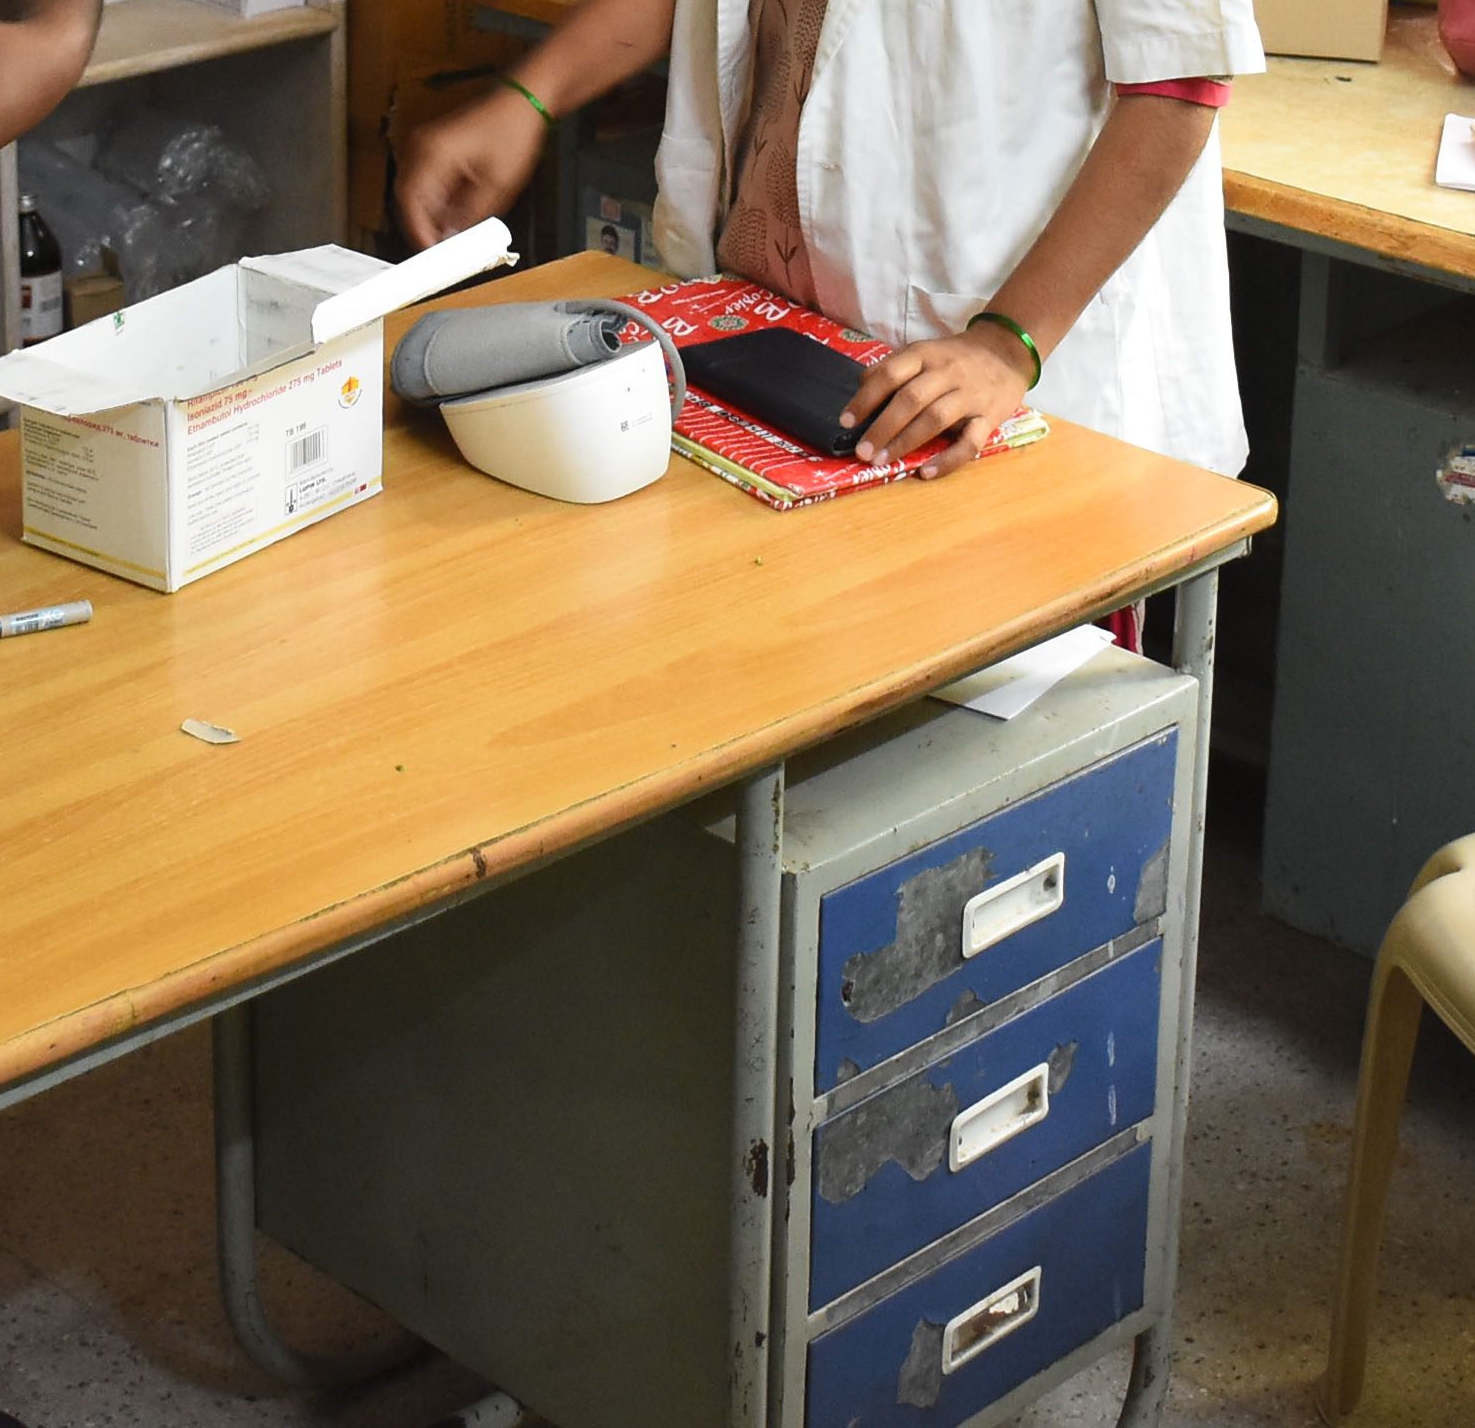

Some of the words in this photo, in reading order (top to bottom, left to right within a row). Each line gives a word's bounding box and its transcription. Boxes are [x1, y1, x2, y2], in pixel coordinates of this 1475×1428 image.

[187, 409, 232, 435] Ethambutol
[233, 385, 287, 415] Hydrochloride
[288, 376, 301, 390] 275
[303, 372, 315, 384] mg
[317, 359, 342, 378] Tablets
[187, 396, 222, 421] Isoniazid
[224, 395, 233, 405] 75
[234, 390, 248, 403] mg
[285, 427, 295, 437] TB
